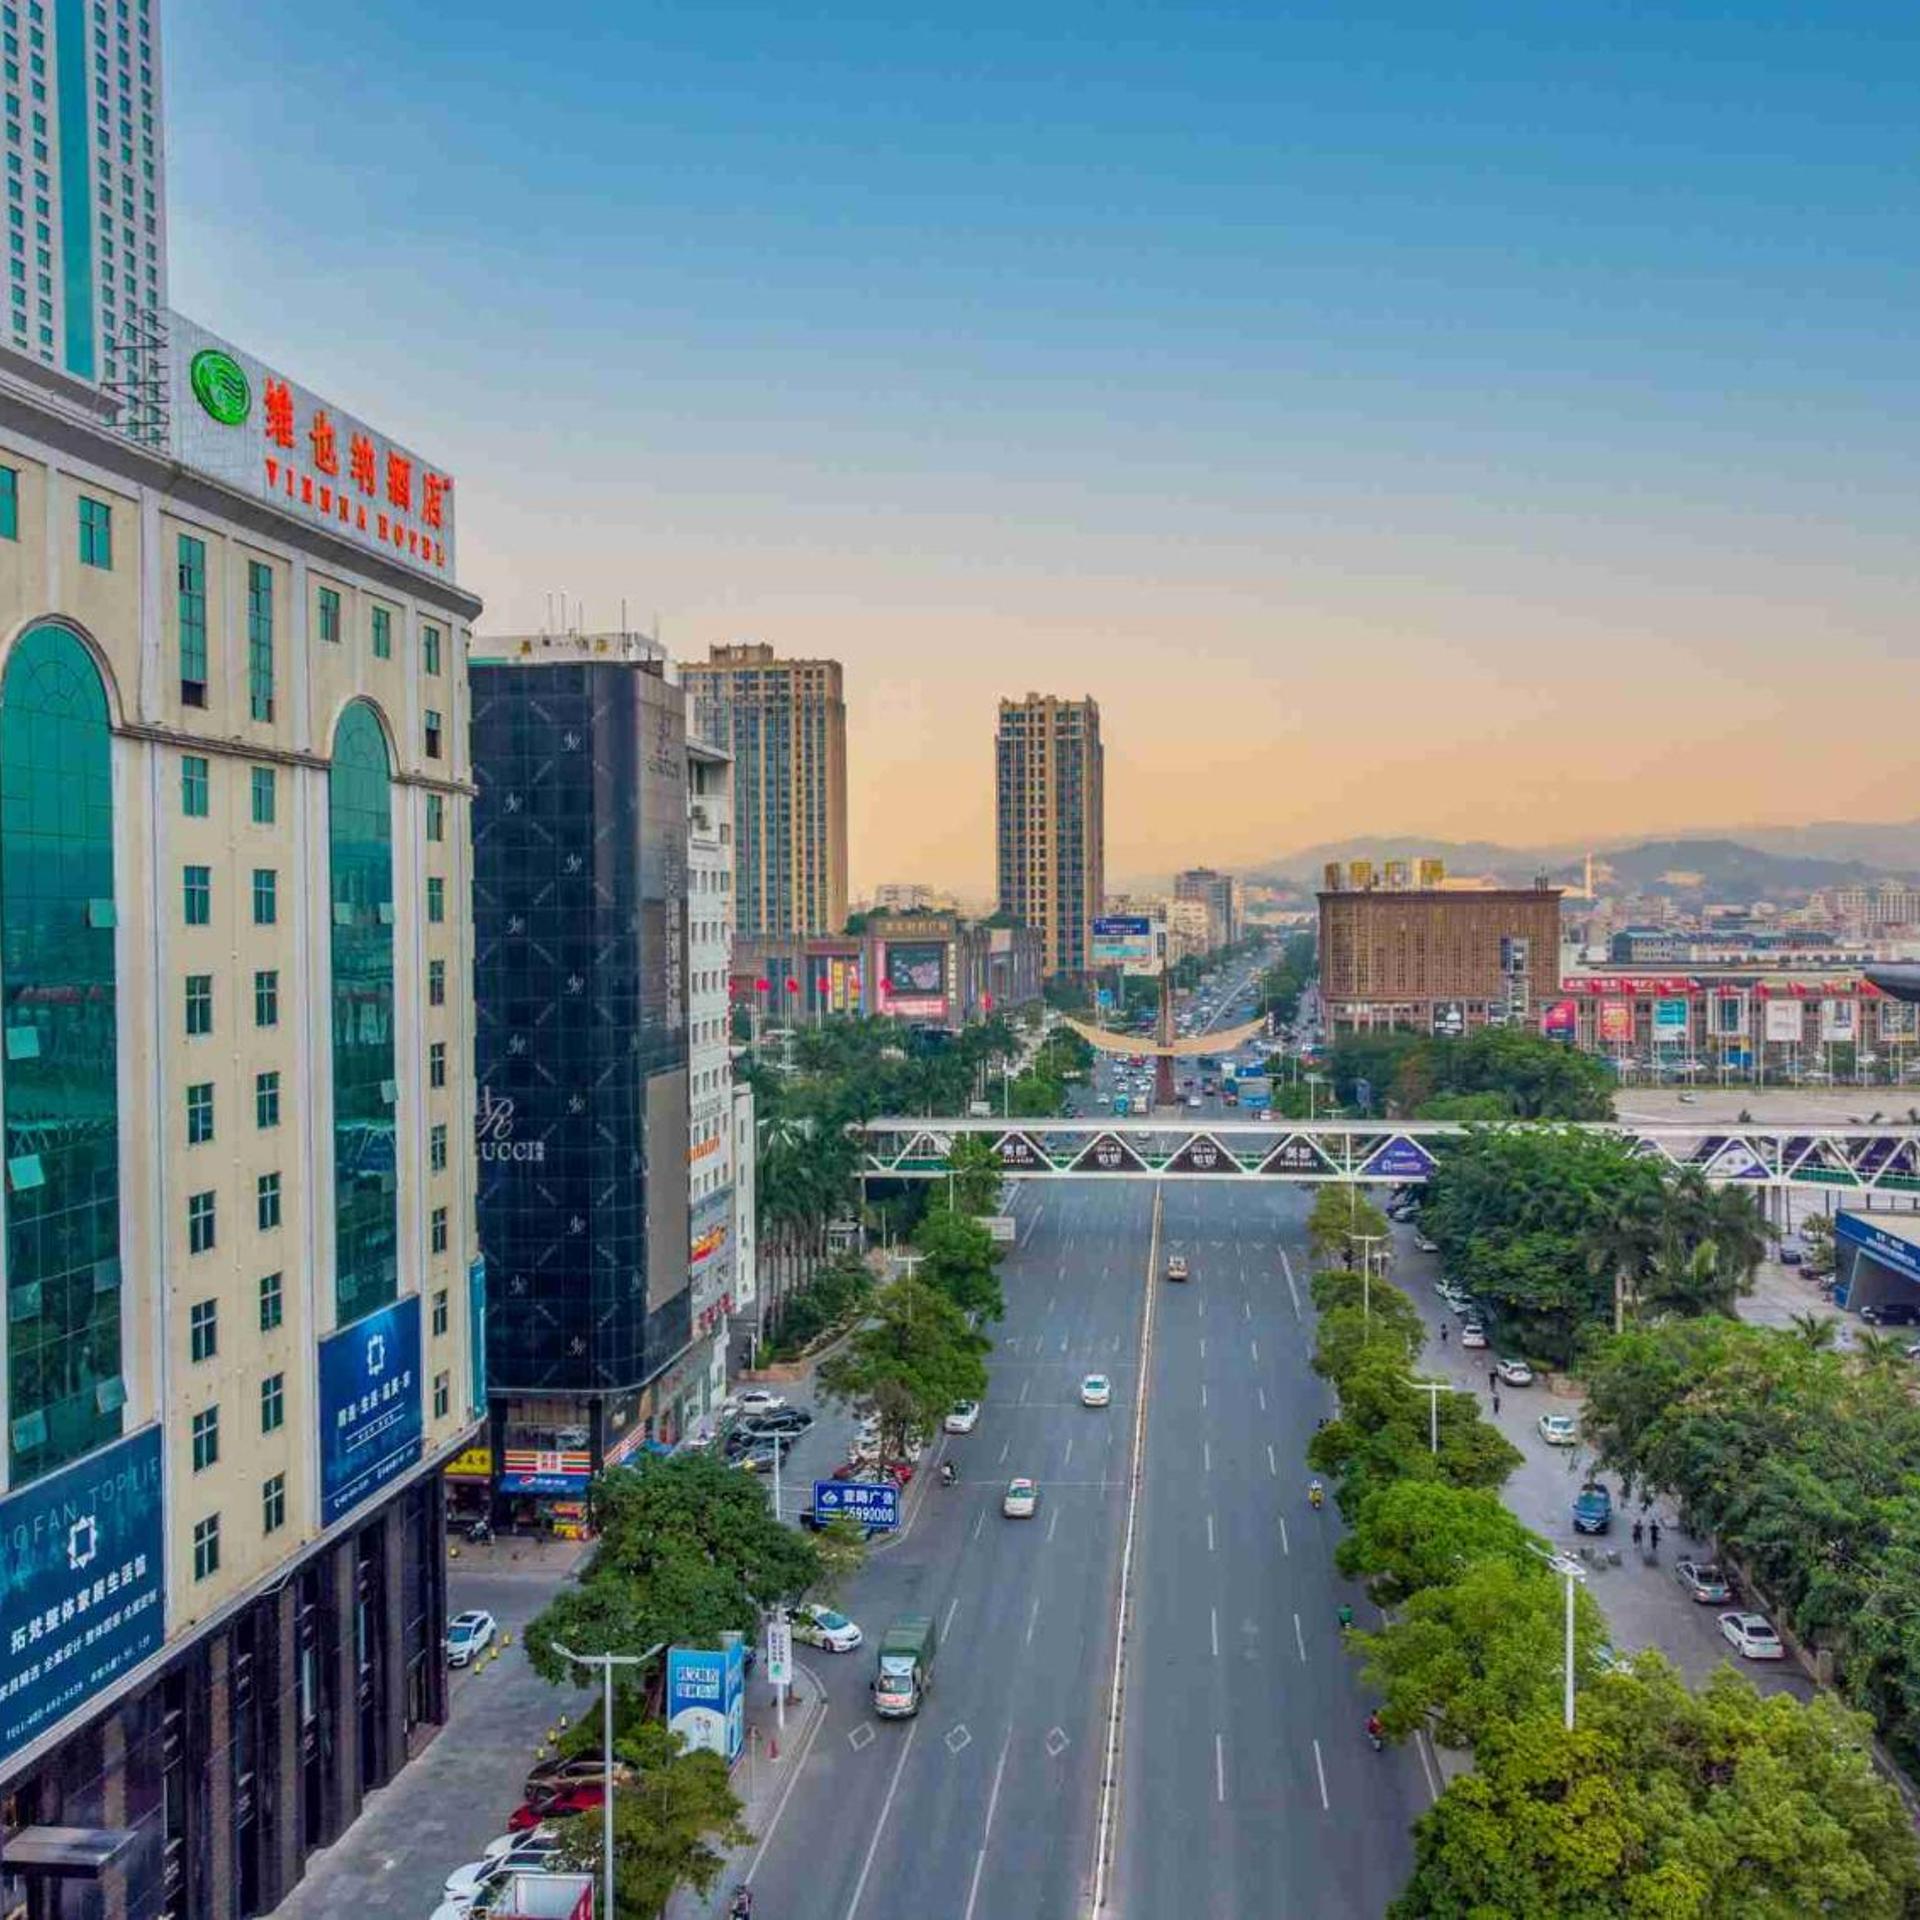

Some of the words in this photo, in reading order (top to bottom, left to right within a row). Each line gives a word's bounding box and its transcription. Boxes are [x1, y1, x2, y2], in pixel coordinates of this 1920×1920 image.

[264, 377, 444, 528] 维也纳酒店
[265, 457, 367, 531] VIENNA
[377, 512, 446, 567] HOTEL
